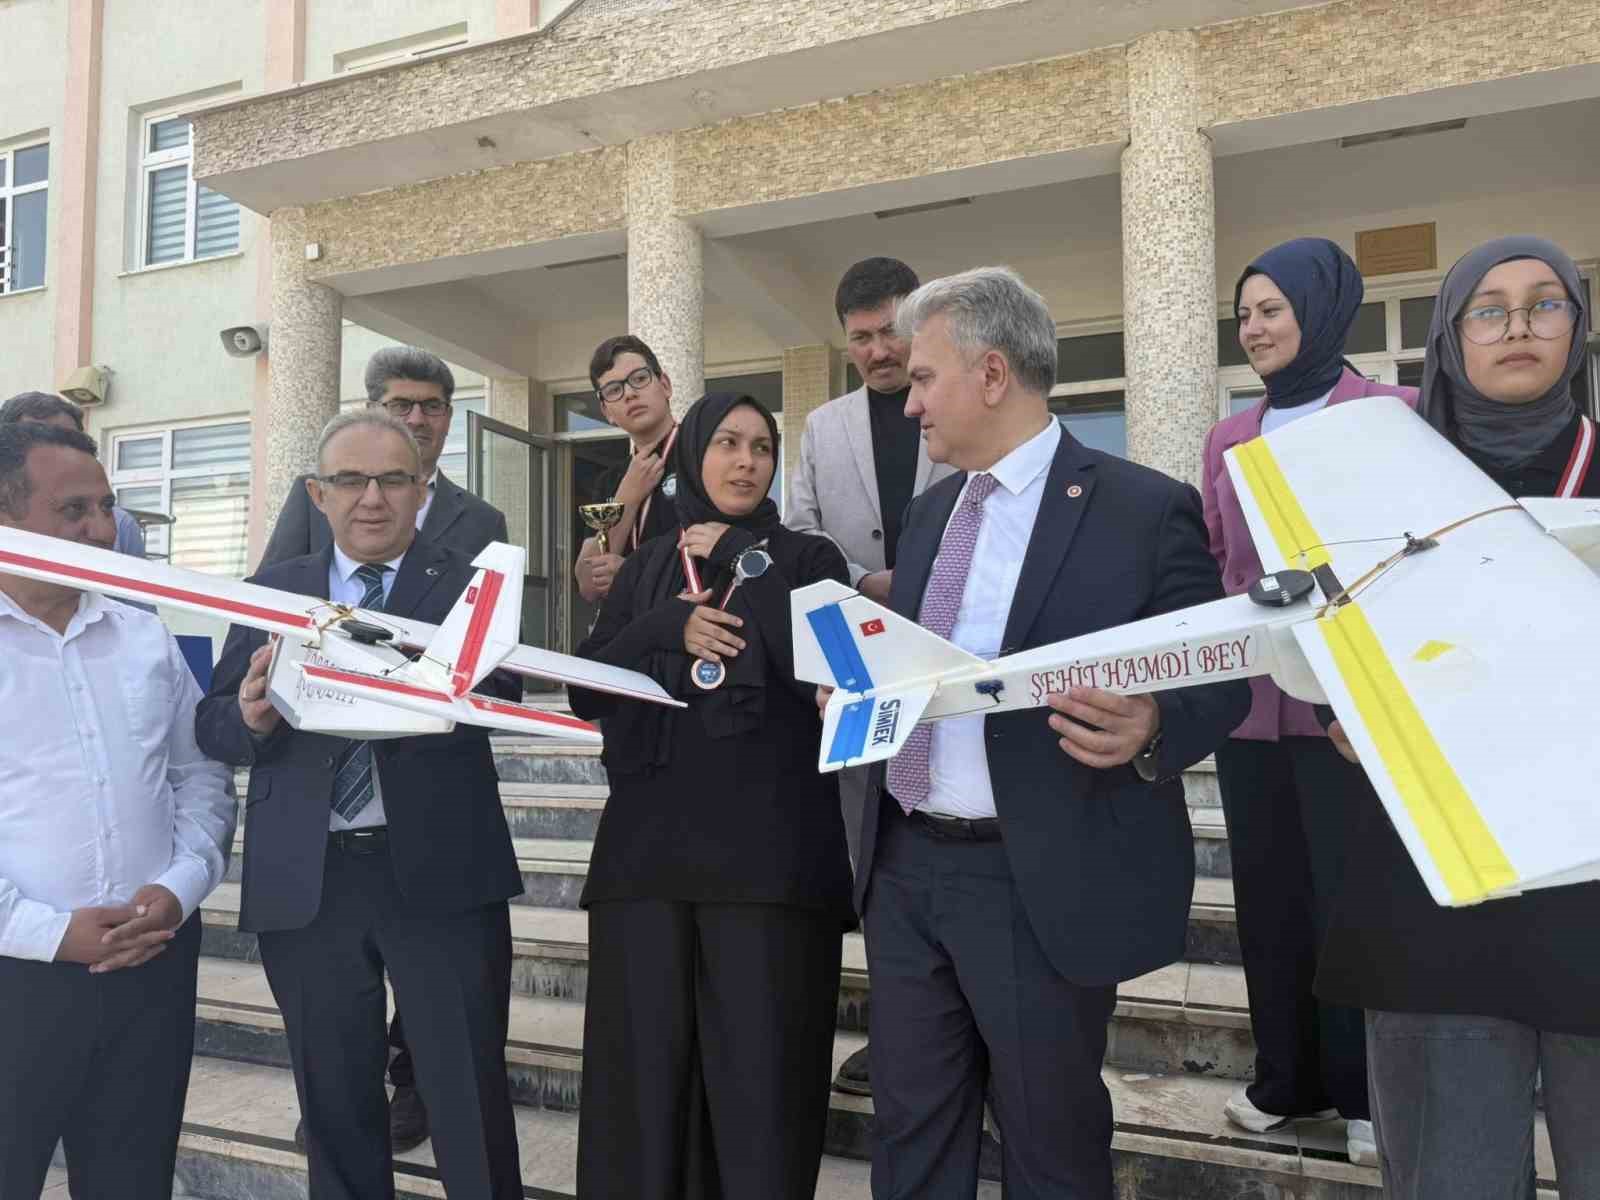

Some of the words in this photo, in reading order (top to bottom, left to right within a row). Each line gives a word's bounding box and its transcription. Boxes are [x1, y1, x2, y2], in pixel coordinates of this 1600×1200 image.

[1031, 660, 1099, 705] ŞEHİT
[1102, 642, 1192, 688] HAMDİ
[1196, 635, 1250, 673] BEY
